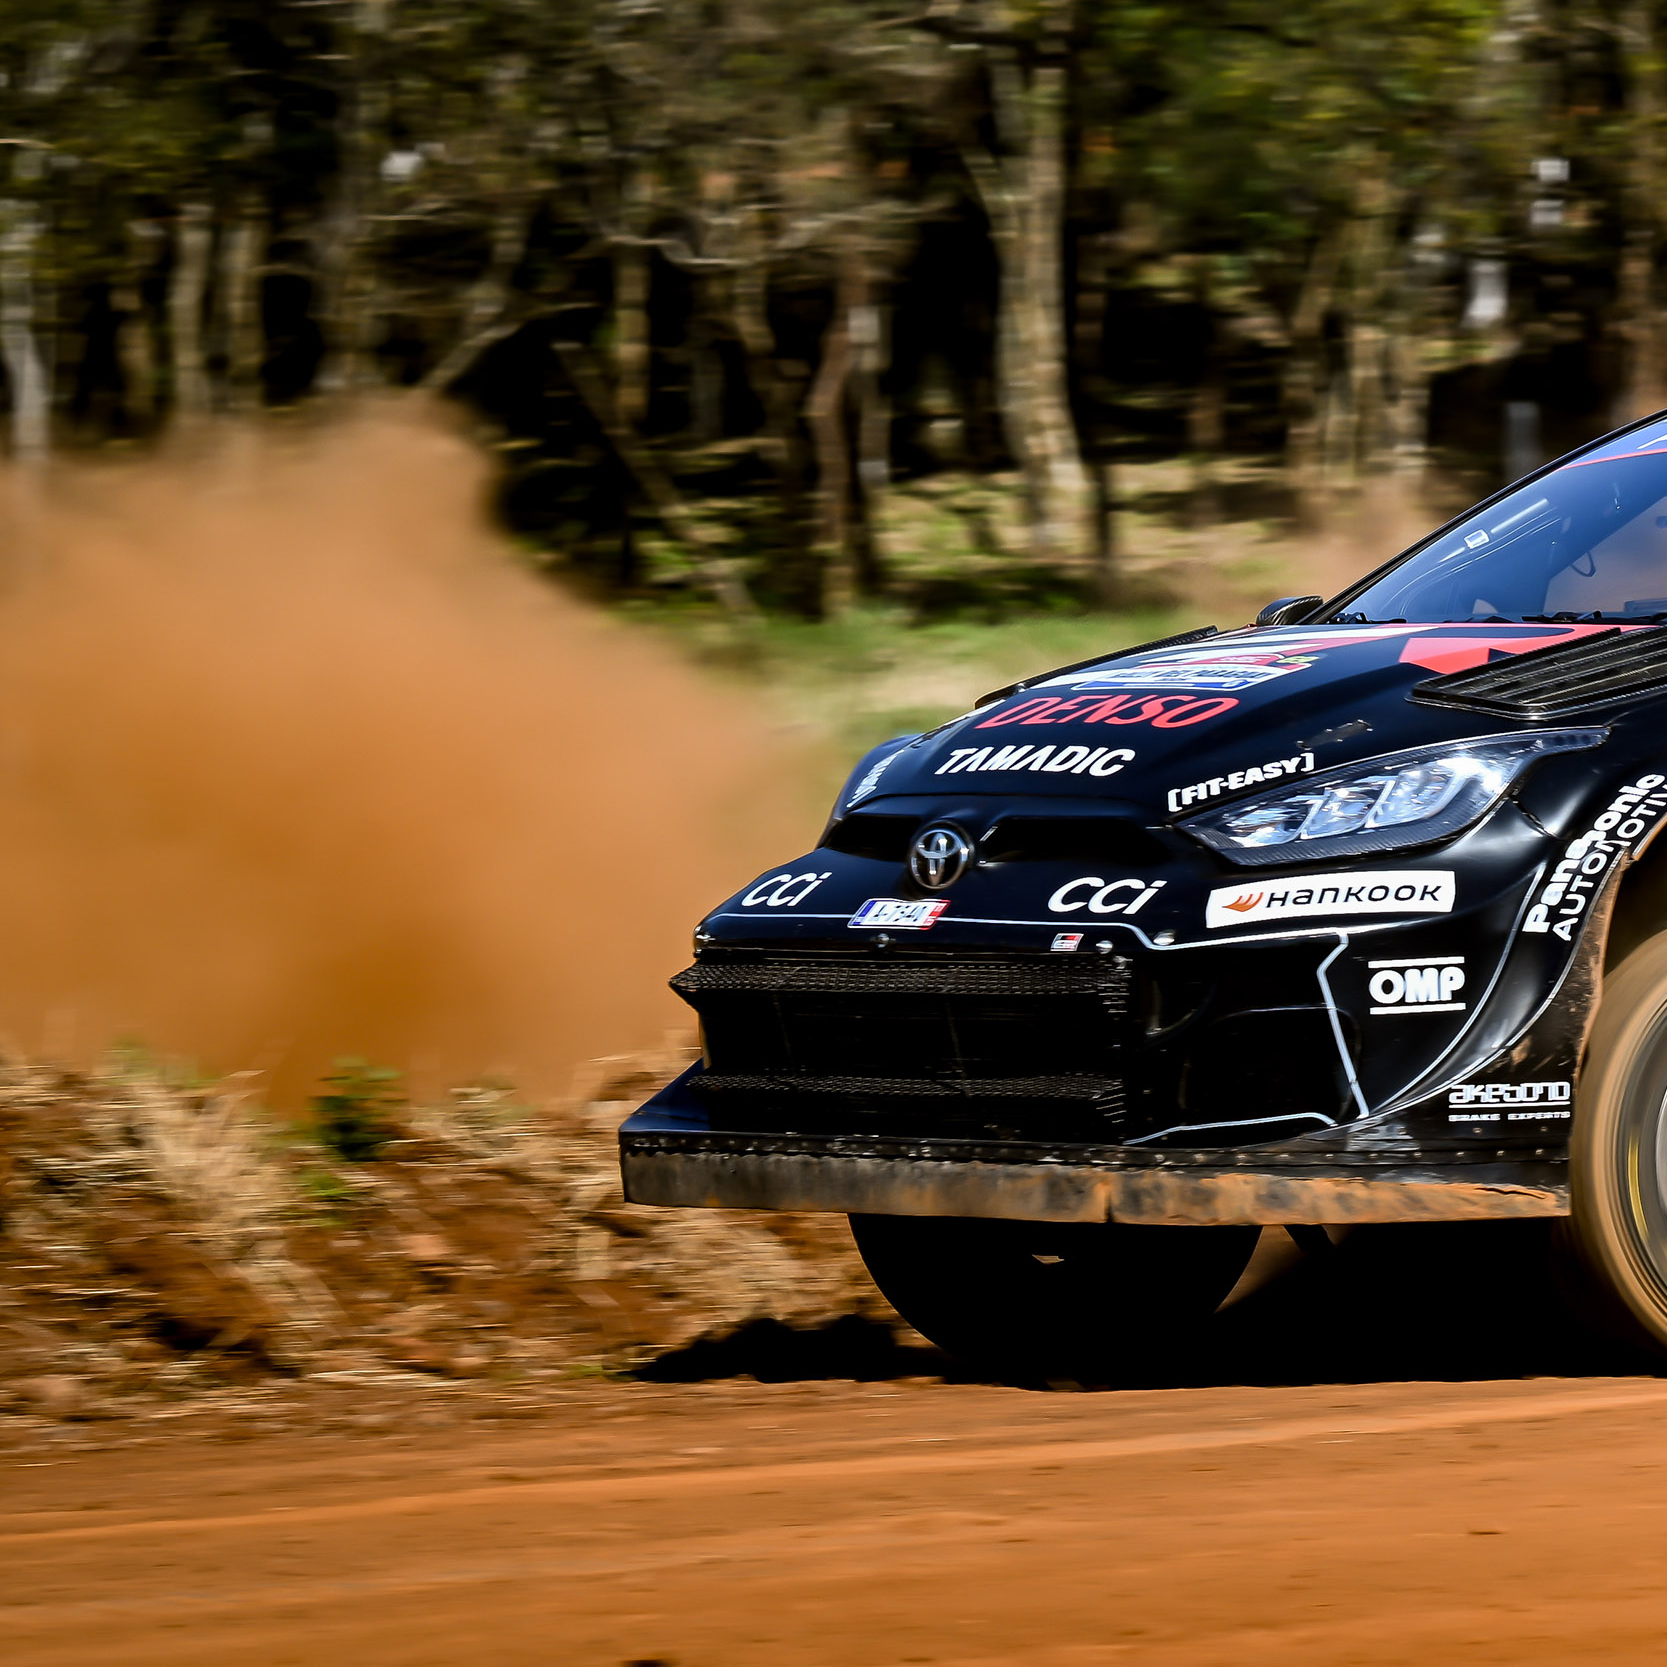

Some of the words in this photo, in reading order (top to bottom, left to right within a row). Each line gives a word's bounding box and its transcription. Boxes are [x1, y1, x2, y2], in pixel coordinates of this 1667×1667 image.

[974, 694, 1240, 729] DENSO
[934, 745, 1136, 776] TAMADIC
[1369, 966, 1466, 1004] OMP
